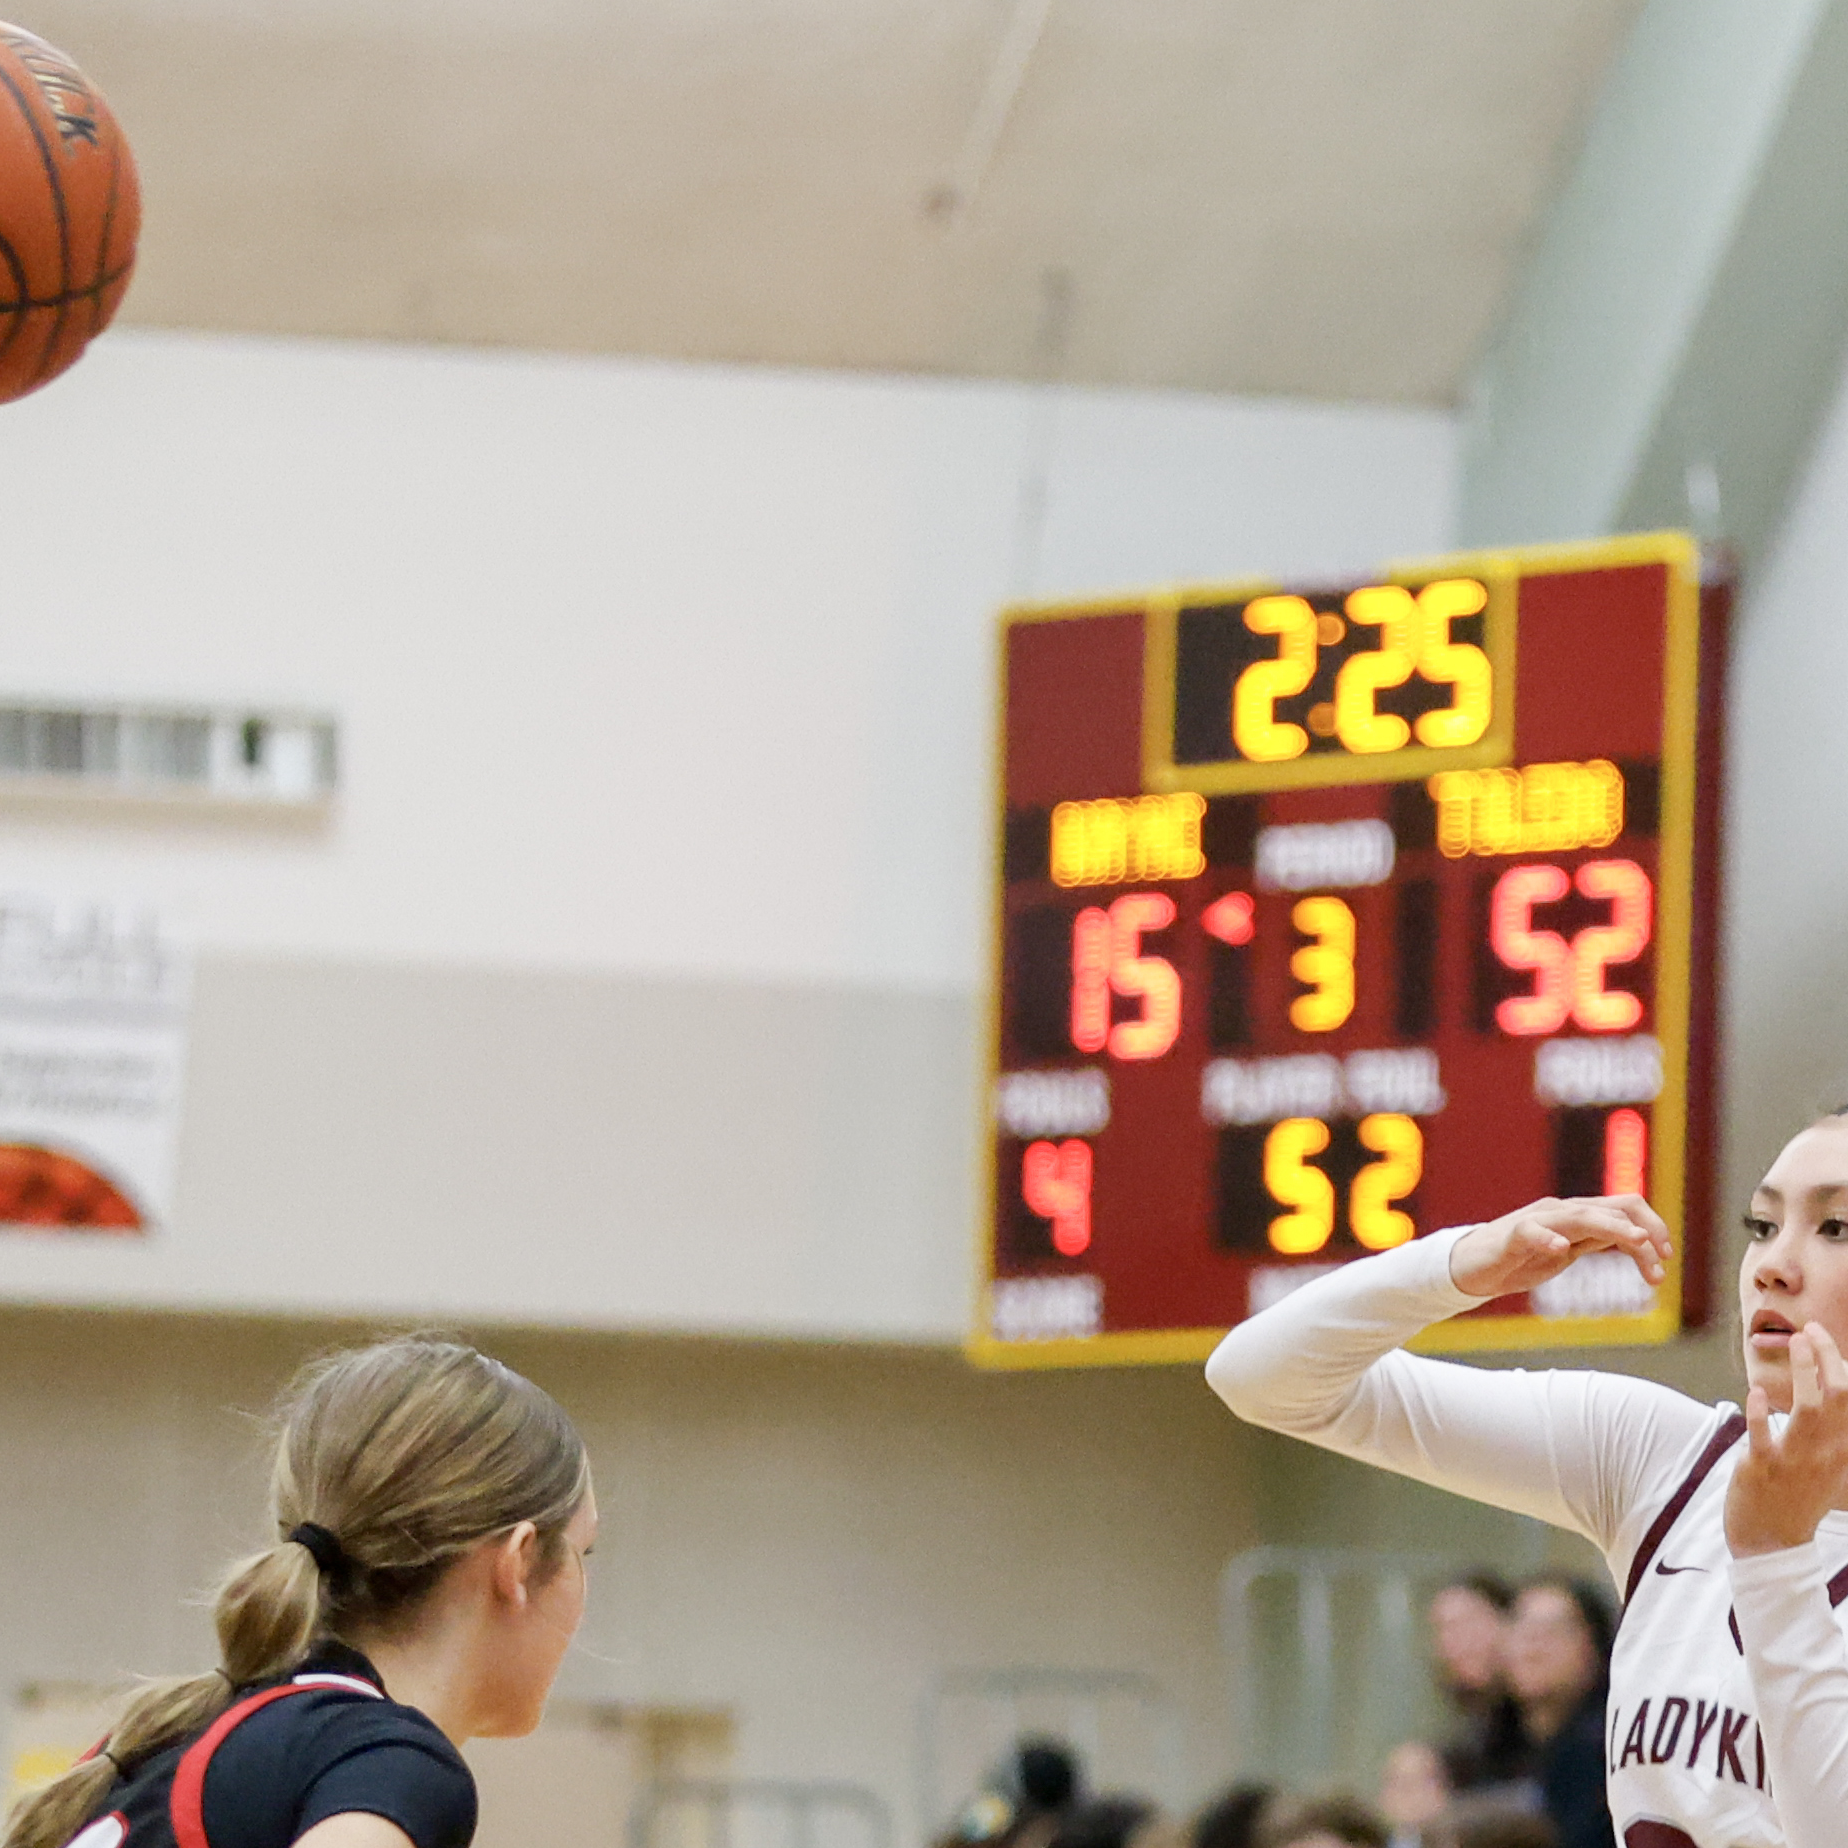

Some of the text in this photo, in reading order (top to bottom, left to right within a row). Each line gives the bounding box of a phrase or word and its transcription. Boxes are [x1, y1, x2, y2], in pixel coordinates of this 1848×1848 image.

[1233, 576, 1493, 762] 2:25
[1071, 892, 1182, 1061] 15
[1289, 895, 1356, 1032] 3
[1490, 858, 1654, 1036] 52
[1022, 1138, 1094, 1257] 4
[1263, 1110, 1424, 1255] 52
[1610, 1697, 1774, 1798] LADYKI
